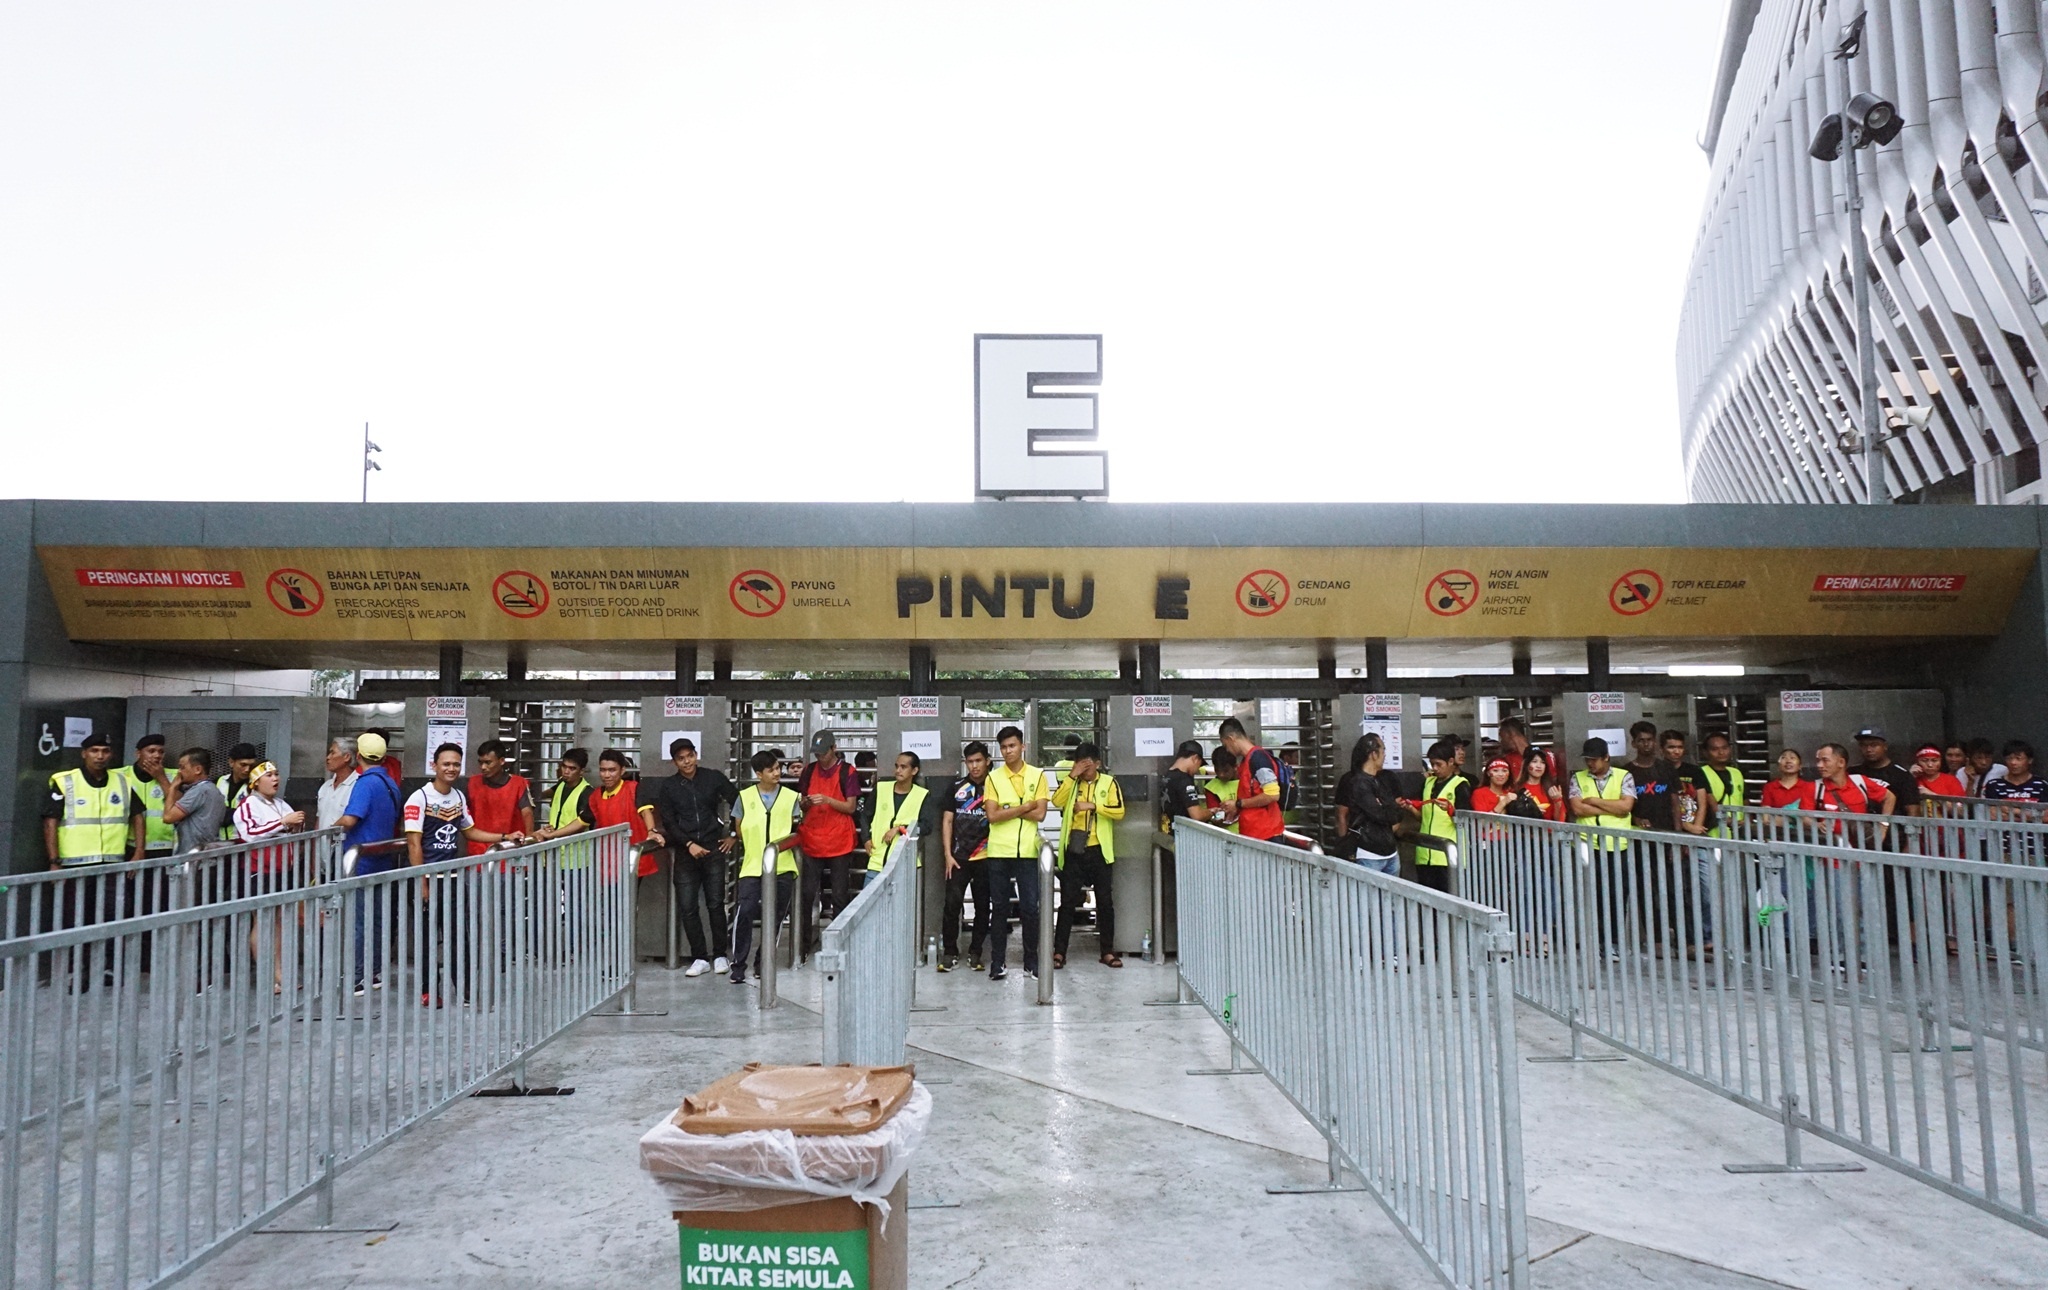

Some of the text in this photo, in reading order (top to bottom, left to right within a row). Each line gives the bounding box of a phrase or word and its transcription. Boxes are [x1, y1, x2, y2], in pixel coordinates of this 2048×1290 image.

[974, 333, 1109, 497] E
[87, 571, 173, 585] PERINGATAN
[182, 573, 232, 586] NOTICE
[327, 571, 421, 580] BAHAN LETUPAN
[551, 570, 690, 580] MAKANAN DAN MINUMAN
[1488, 570, 1549, 579] HON ANGIN
[330, 582, 470, 591] BUNGA API DAN SENJATA
[553, 581, 591, 590] BOTOL
[599, 581, 617, 590] TIN
[620, 581, 646, 590] DARI
[650, 581, 680, 590] LUAR
[791, 581, 836, 590] PAYUNG
[1297, 581, 1351, 590] GENDANG
[1488, 581, 1520, 589] WISEL
[1671, 581, 1746, 589] TOPI KELEDAR
[1823, 577, 1901, 589] PERINGATAN
[1908, 577, 1955, 589] NOTICE
[896, 573, 1191, 620] PINTU E
[1483, 596, 1531, 605] AIRHORN
[334, 599, 420, 608] FIRECRACKERS
[557, 598, 665, 607] OUTSIDE FOOD AND
[793, 598, 851, 607] UMBRELLA
[1294, 597, 1326, 606] DRUM
[1665, 597, 1708, 606] HELMET
[187, 610, 202, 618] THE
[204, 610, 238, 618] STADIUM
[337, 610, 466, 619] EXPLOSIVES & WEAPON
[559, 608, 609, 618] BOTTLED
[618, 608, 663, 617] CANNED
[666, 608, 700, 617] DRINK
[1481, 607, 1527, 616] WHISTLE
[698, 1243, 839, 1266] BUKAN SISA
[687, 1265, 854, 1289] KITAR SEMULA
